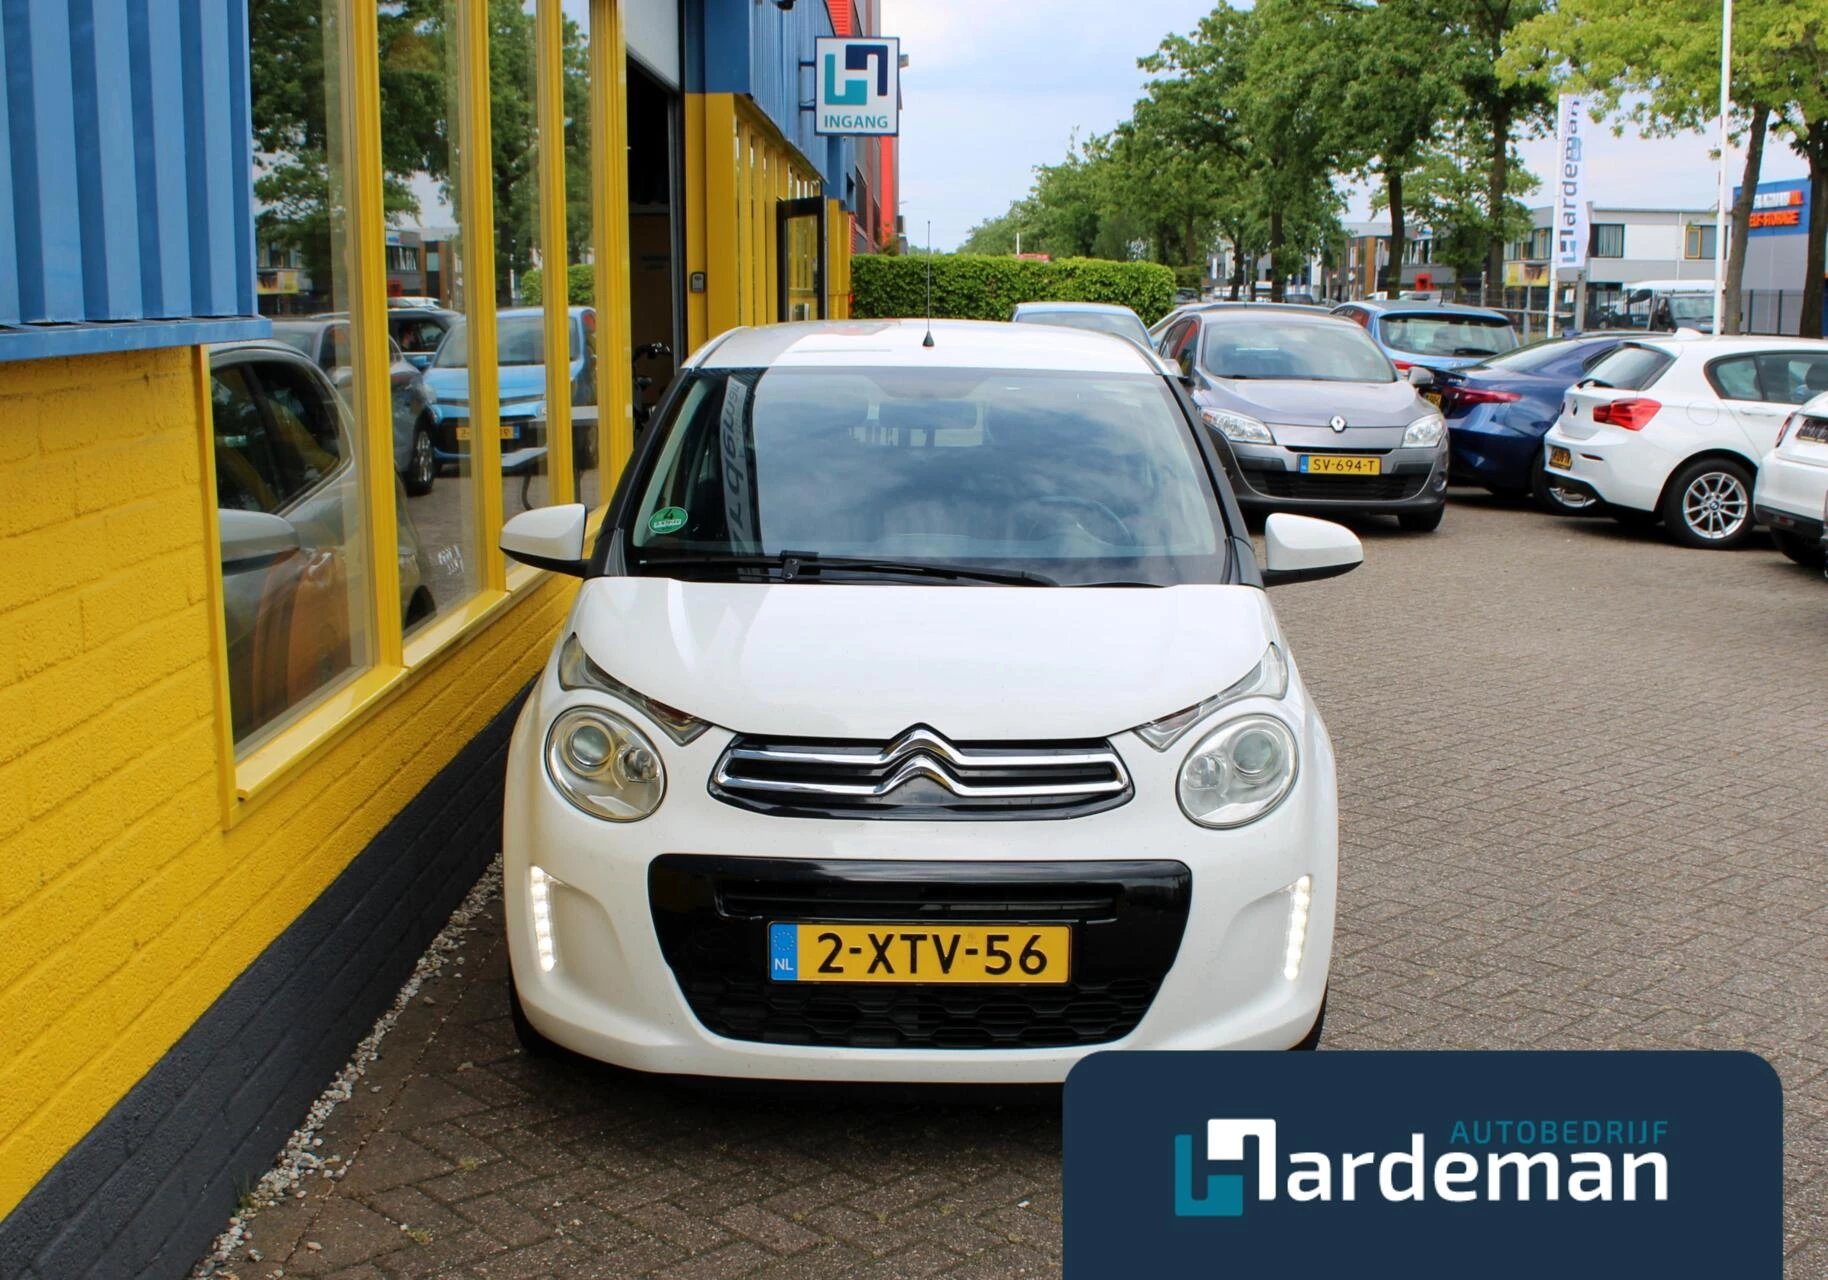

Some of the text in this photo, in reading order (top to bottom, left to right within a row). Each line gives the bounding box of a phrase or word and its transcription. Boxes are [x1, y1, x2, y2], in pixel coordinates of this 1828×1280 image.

[824, 114, 888, 128] INGANG
[1313, 458, 1375, 472] SV-694-T
[817, 932, 1048, 976] 2-XTV-56
[774, 957, 794, 971] NL
